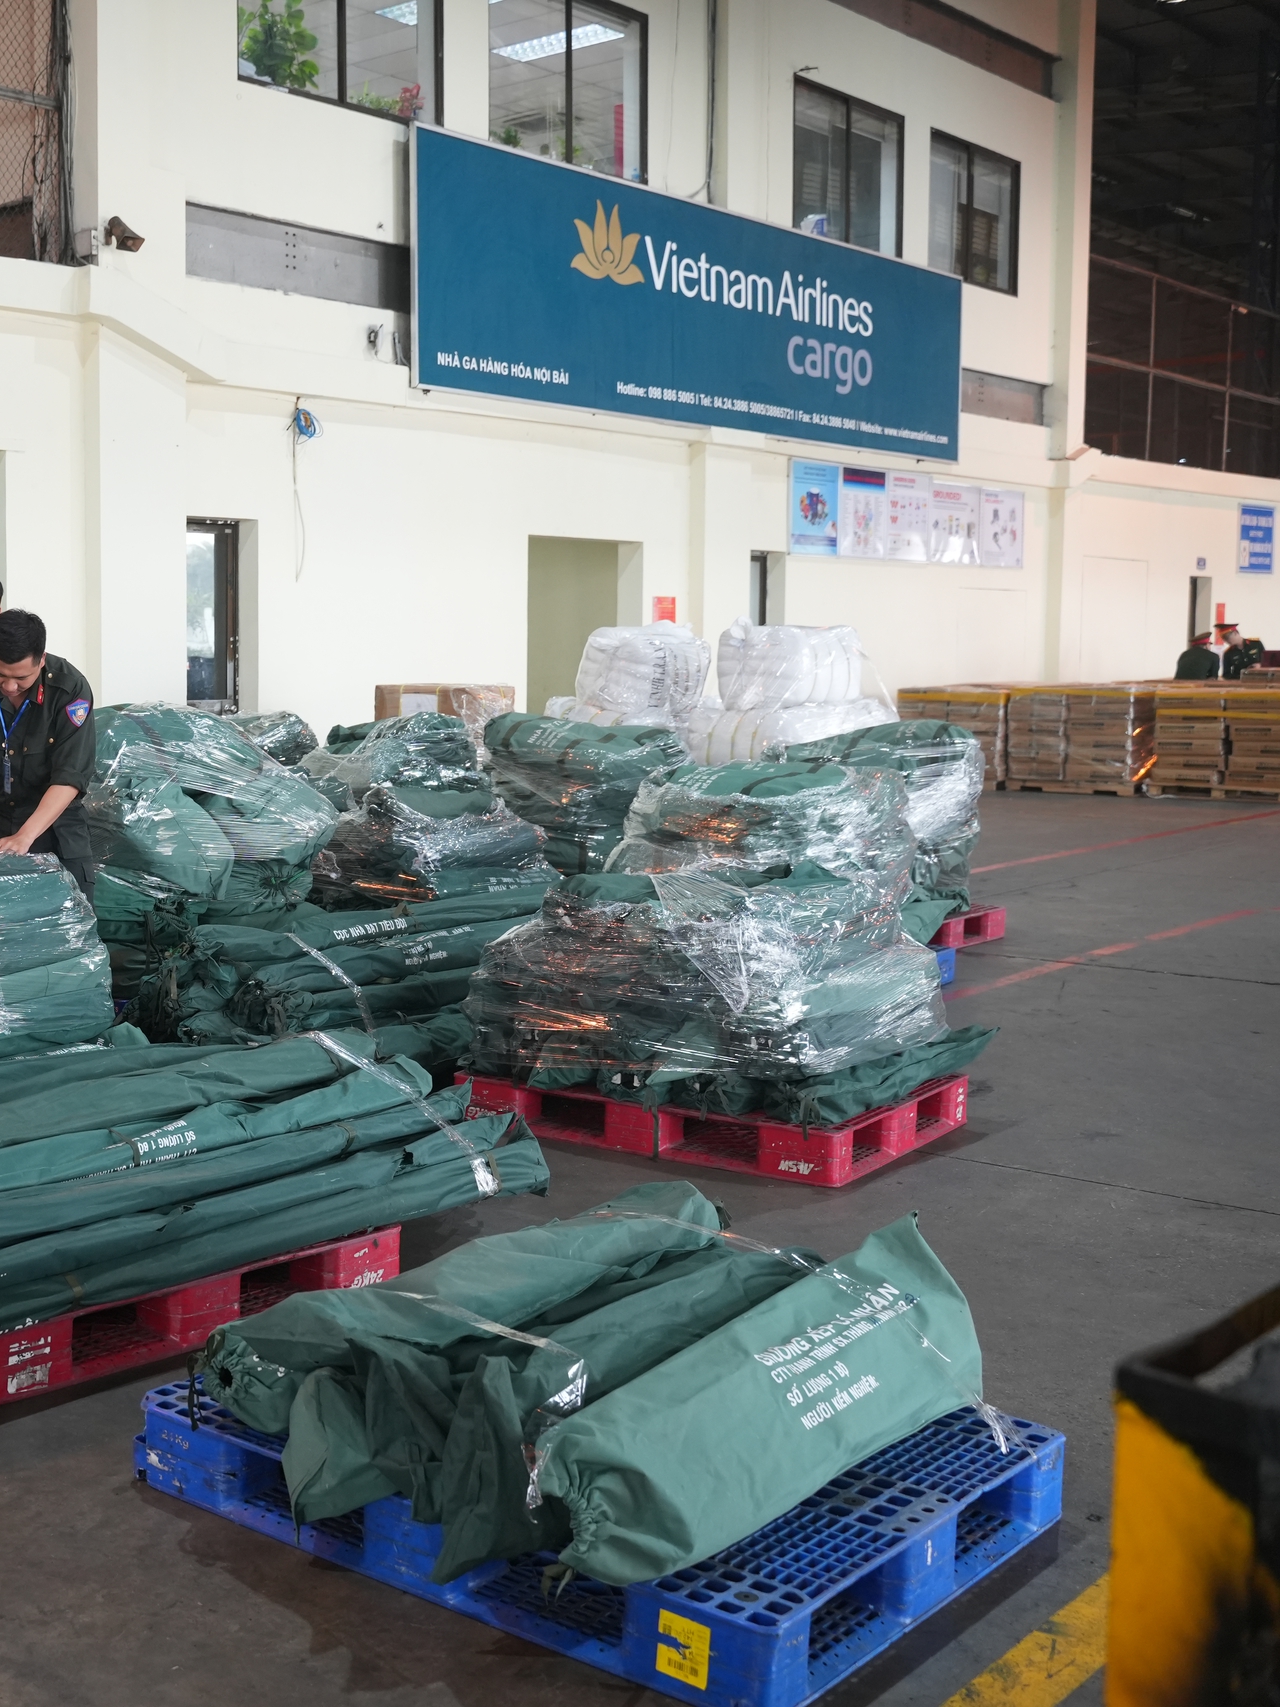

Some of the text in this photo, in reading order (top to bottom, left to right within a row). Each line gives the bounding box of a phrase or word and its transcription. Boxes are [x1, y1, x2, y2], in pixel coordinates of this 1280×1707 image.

[644, 235, 874, 337] Vietnam Airlines
[437, 351, 569, 385] NHÀ GA HÀNG HÓA NỘI BÀI
[787, 335, 873, 395] cargo
[617, 381, 647, 397] Hotline:
[648, 386, 662, 400] 098
[677, 391, 695, 404] 5005
[700, 394, 713, 407] Tel:
[771, 1365, 792, 1384] CTY
[786, 1360, 850, 1407] SỐ LƯỢNG 1 BỘ
[800, 1374, 880, 1430] NGƯỜI KIỂM NGHIỆM:
